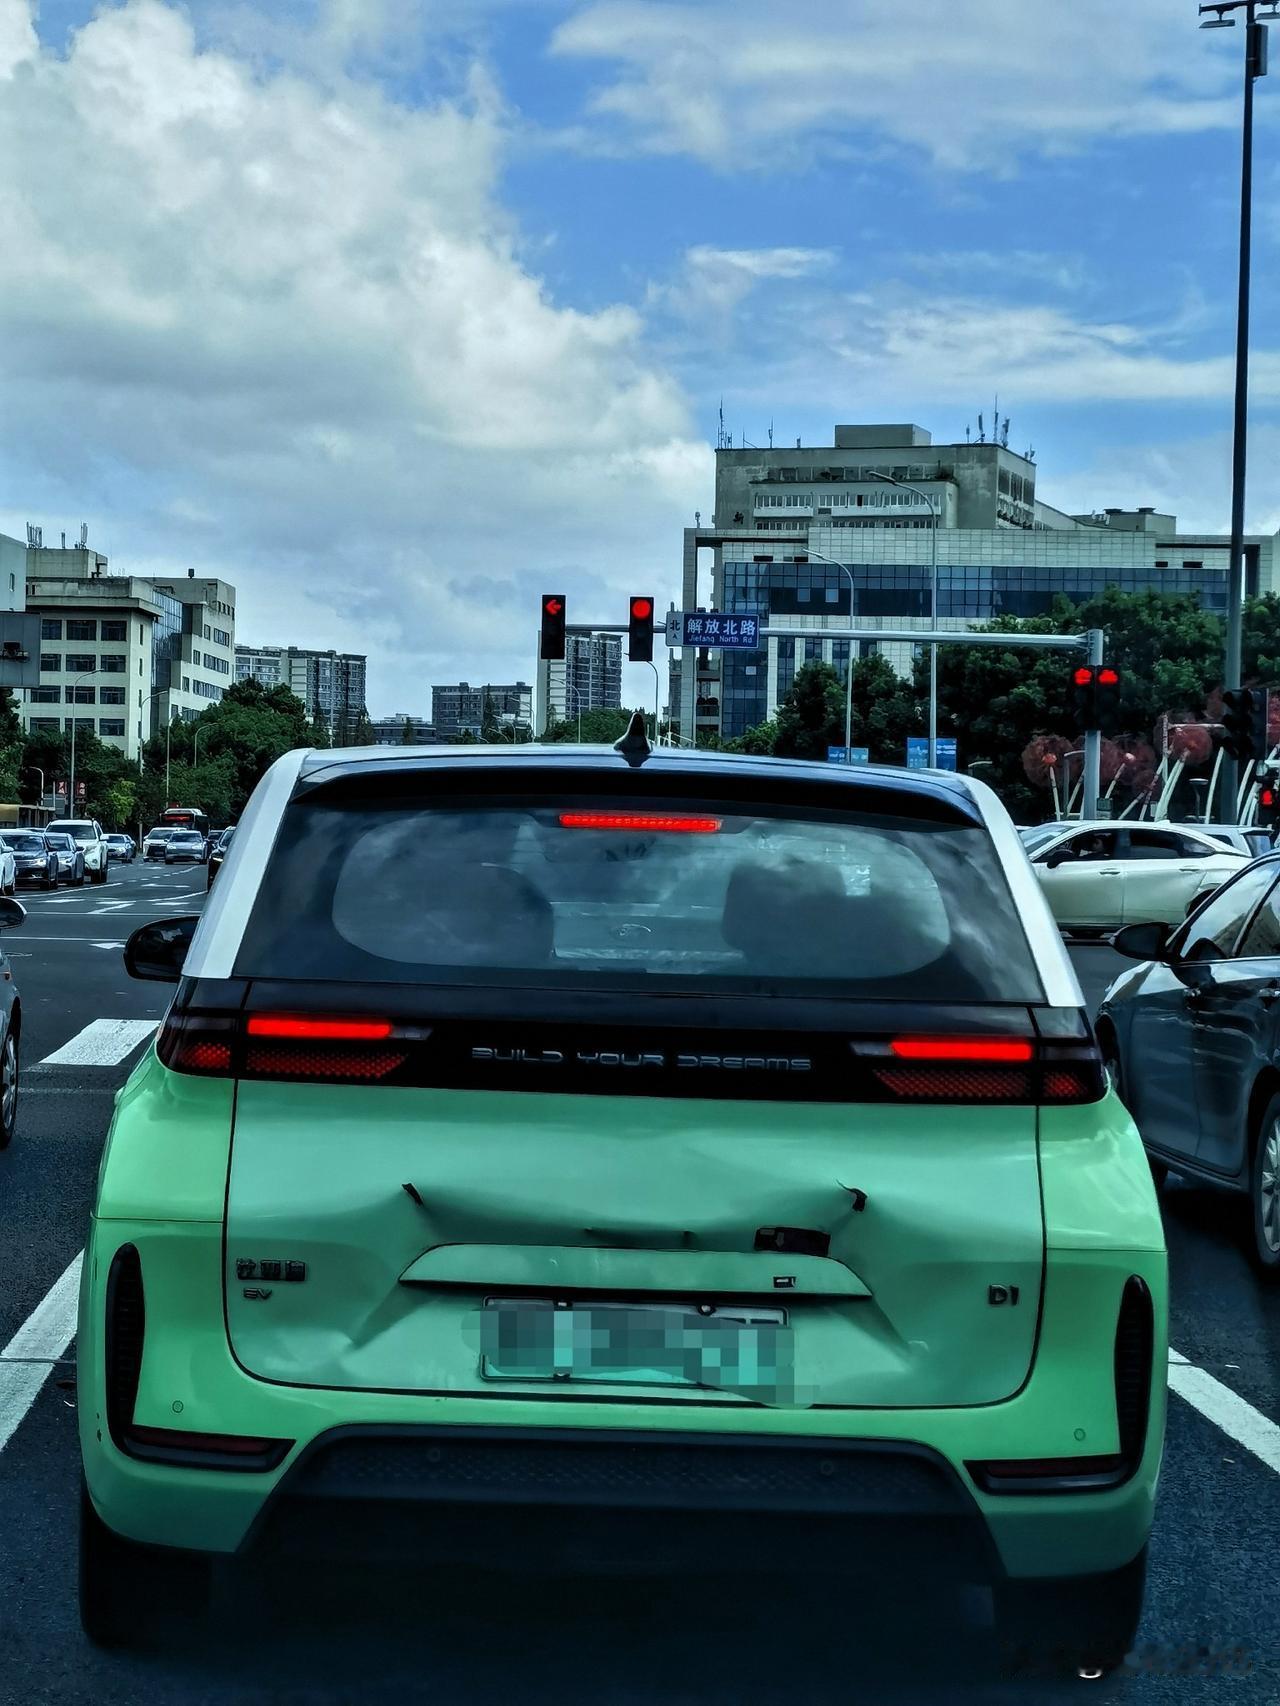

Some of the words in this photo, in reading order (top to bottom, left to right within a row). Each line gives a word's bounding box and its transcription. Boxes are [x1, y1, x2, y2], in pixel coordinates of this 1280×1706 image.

[669, 619, 681, 631] 北
[687, 618, 756, 636] 解放北路
[689, 635, 715, 644] Jiefang
[719, 635, 739, 643] North
[742, 636, 753, 644] Rd
[472, 1047, 563, 1063] BUILD
[577, 1052, 664, 1066] YOUR
[677, 1055, 811, 1071] DREAMS
[243, 1287, 273, 1300] EV
[988, 1284, 1019, 1306] D1
